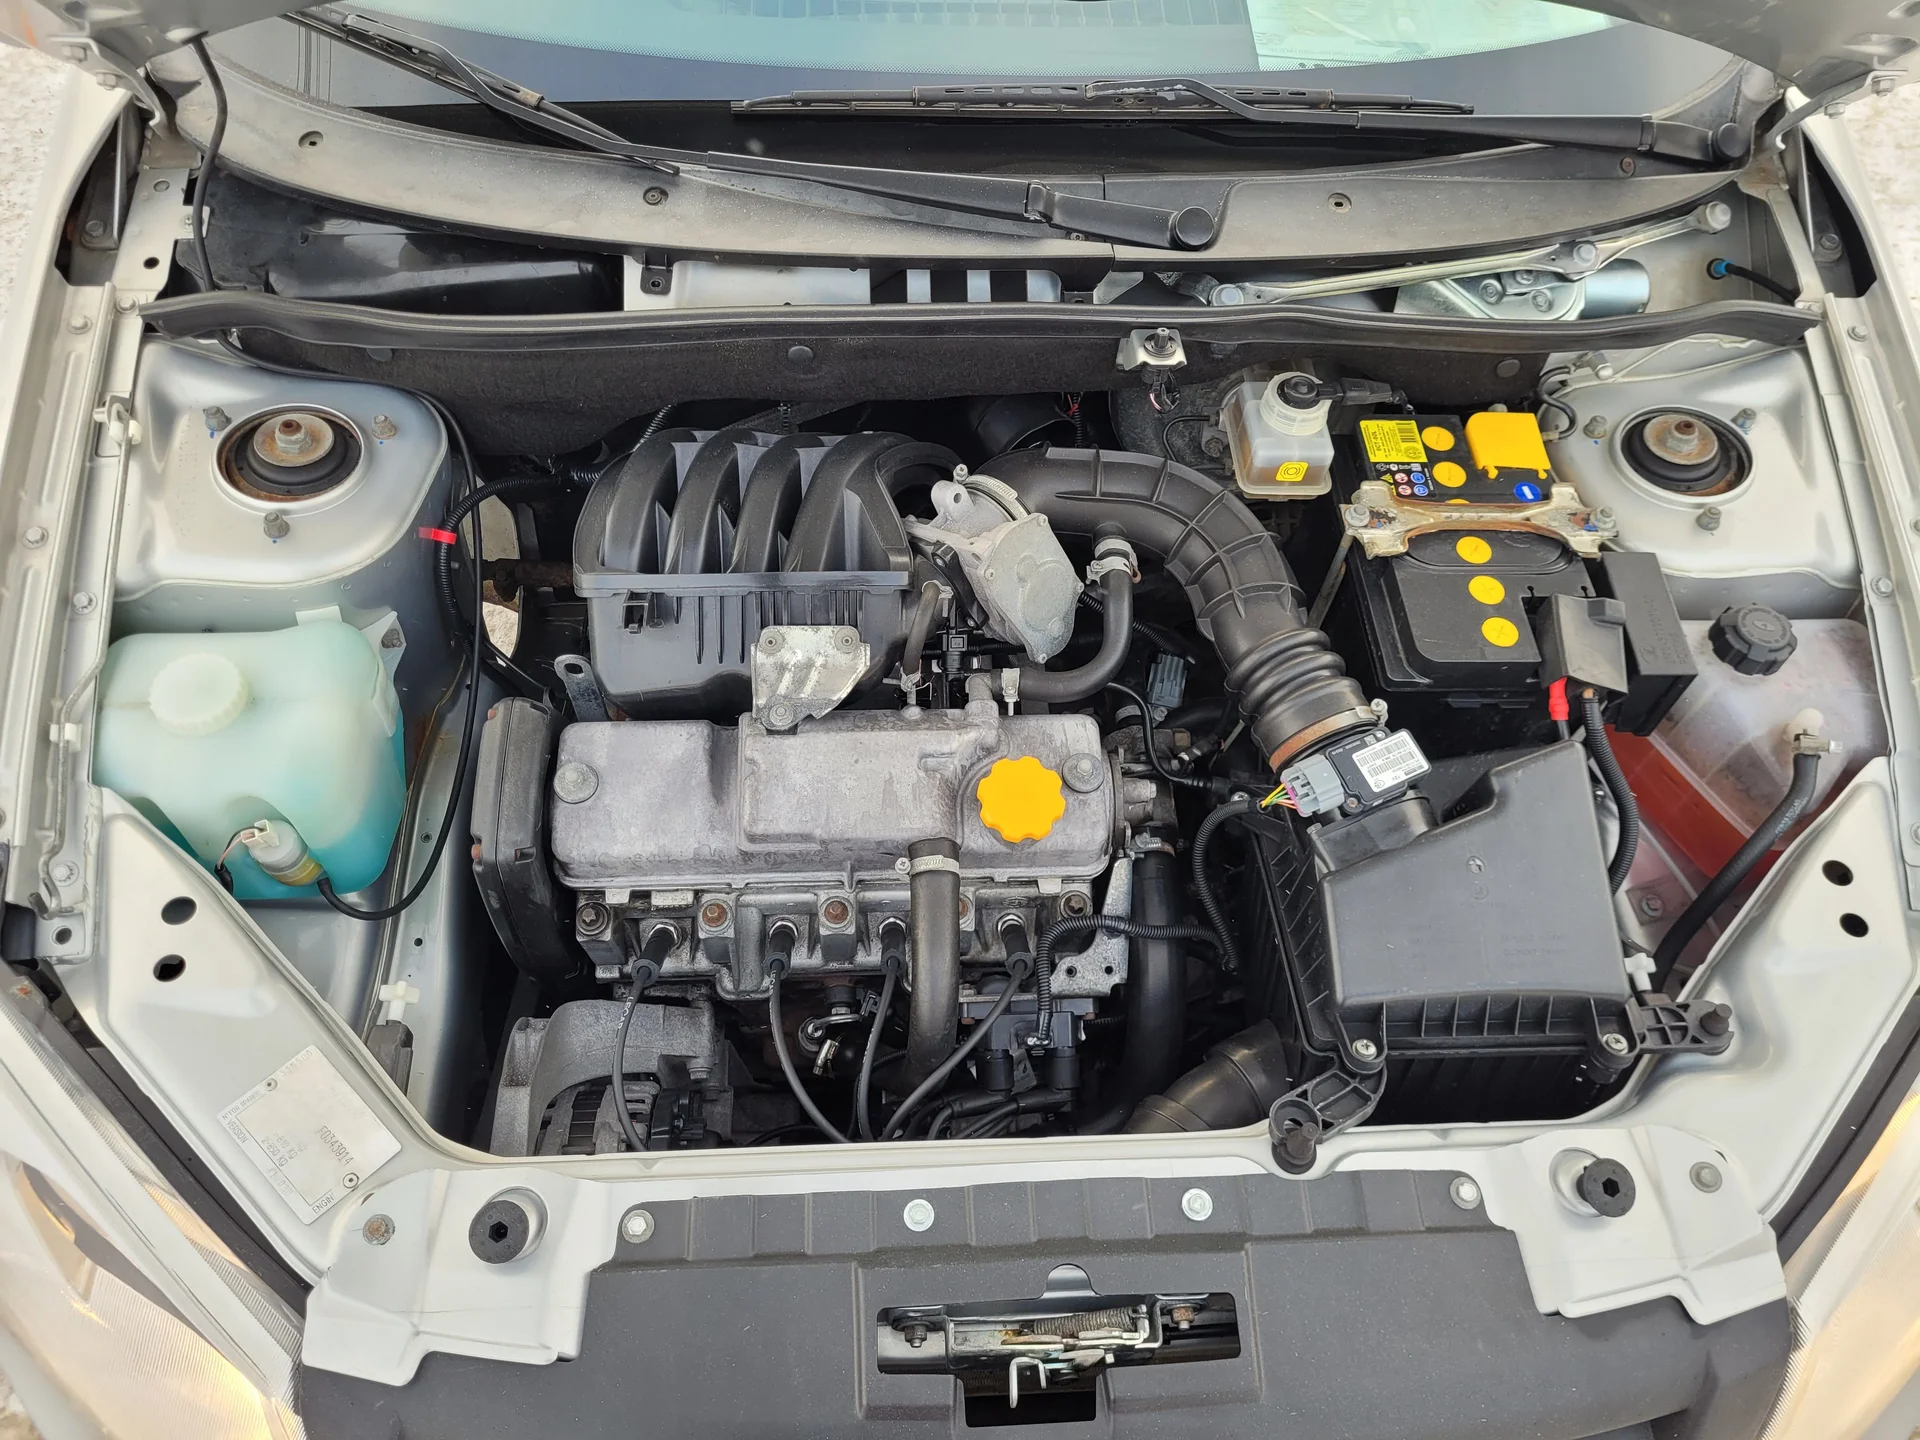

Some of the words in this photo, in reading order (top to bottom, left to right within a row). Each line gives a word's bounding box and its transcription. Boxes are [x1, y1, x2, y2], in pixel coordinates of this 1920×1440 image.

[227, 1119, 249, 1144] VERSION
[261, 1136, 280, 1157] 2-850
[314, 1125, 354, 1166] F0343914
